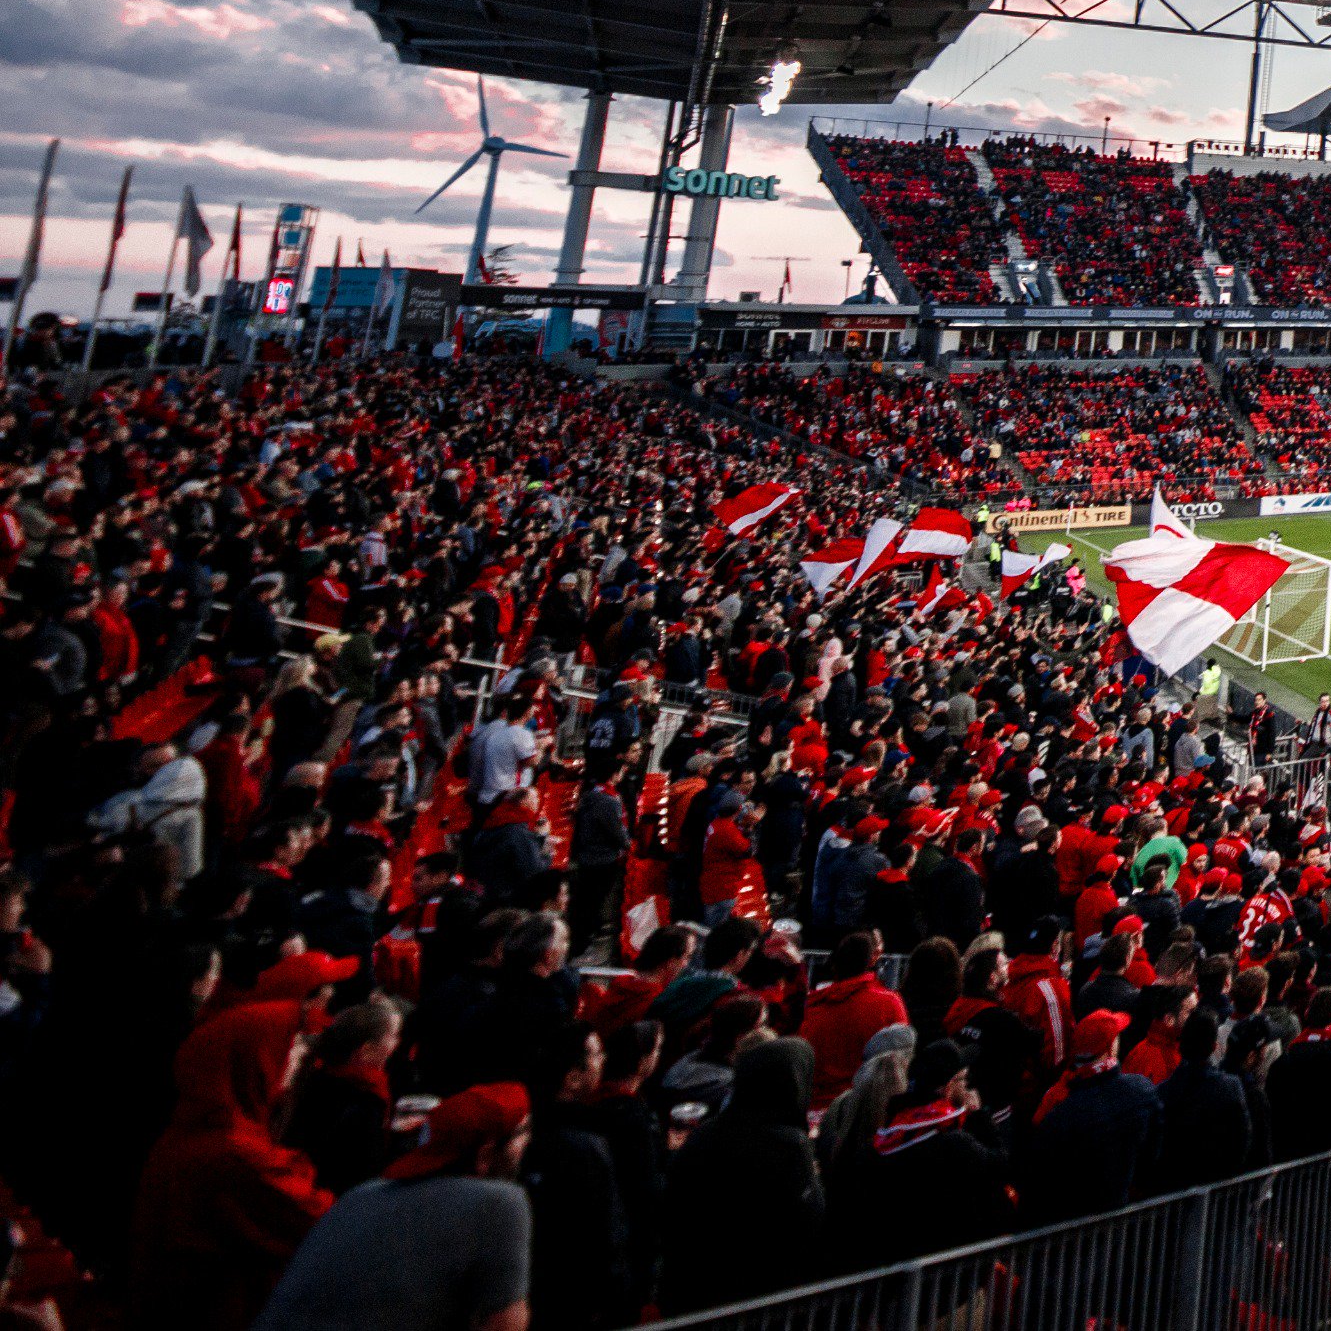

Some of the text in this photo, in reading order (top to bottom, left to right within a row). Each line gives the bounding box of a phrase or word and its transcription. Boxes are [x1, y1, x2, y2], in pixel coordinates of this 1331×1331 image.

[665, 166, 780, 201] sonnet
[1194, 310, 1213, 318] ON
[1271, 310, 1291, 319] ON
[1094, 510, 1126, 522] TIRE
